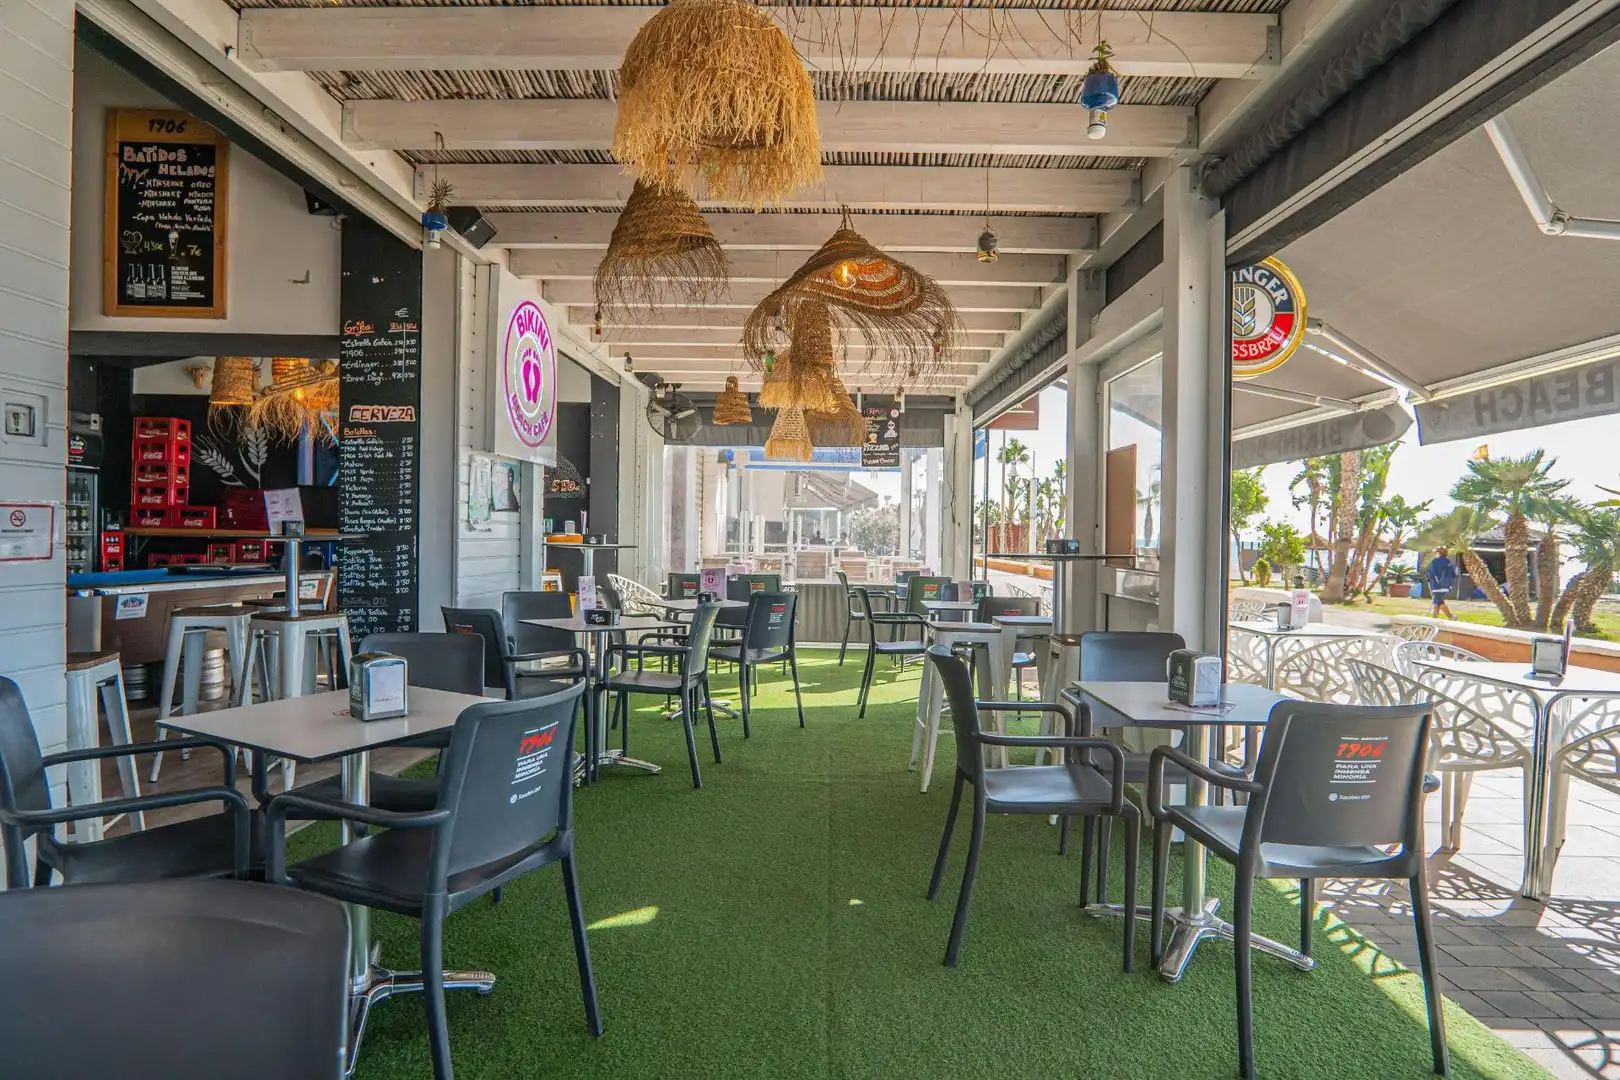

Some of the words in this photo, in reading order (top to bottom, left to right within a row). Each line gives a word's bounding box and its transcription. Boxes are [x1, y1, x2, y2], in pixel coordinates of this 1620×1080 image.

[148, 118, 188, 134] 1906
[516, 309, 549, 353] BIKINI
[350, 406, 415, 422] CERVEZA
[511, 393, 533, 437] BEACH
[518, 726, 558, 755] 1906
[1336, 741, 1388, 759] 1906
